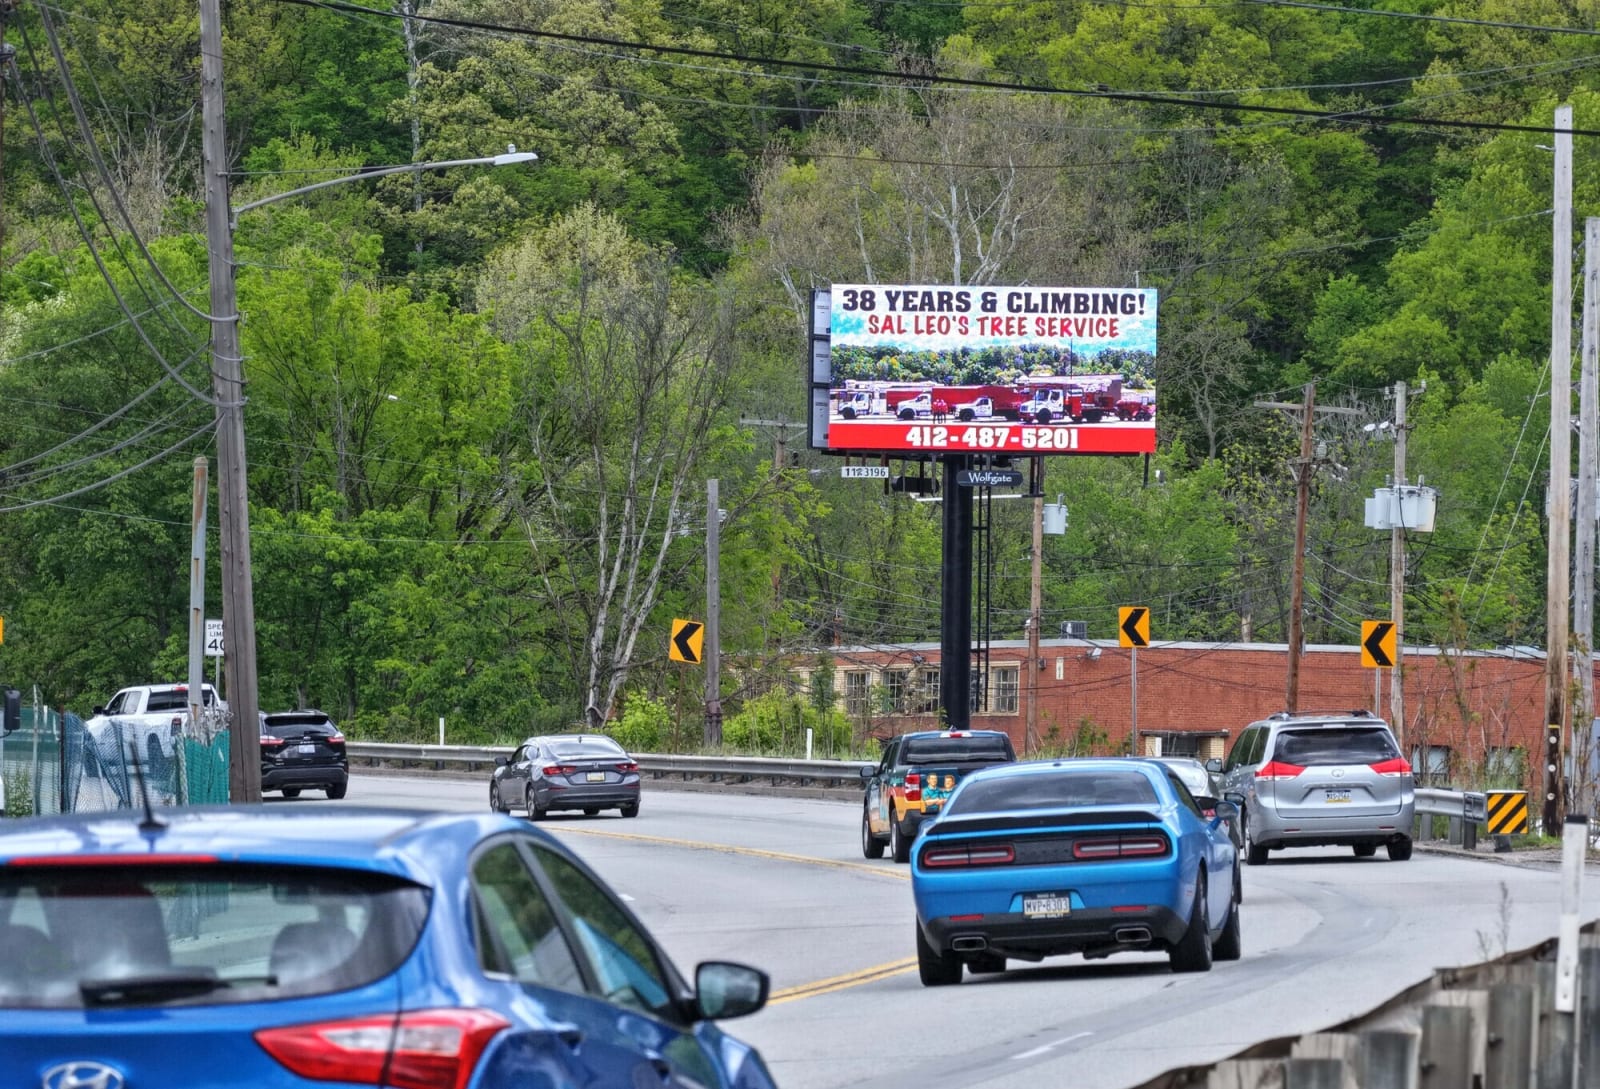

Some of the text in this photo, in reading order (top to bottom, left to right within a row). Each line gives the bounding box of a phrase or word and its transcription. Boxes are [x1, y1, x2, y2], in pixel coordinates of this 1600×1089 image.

[843, 289, 1146, 315] 38 YEARS & CLIMBING!
[868, 314, 1120, 338] SAL LEO'S TREE SERVICE
[906, 426, 1079, 449] 412-487-5201
[968, 471, 1013, 485] Wolfgate
